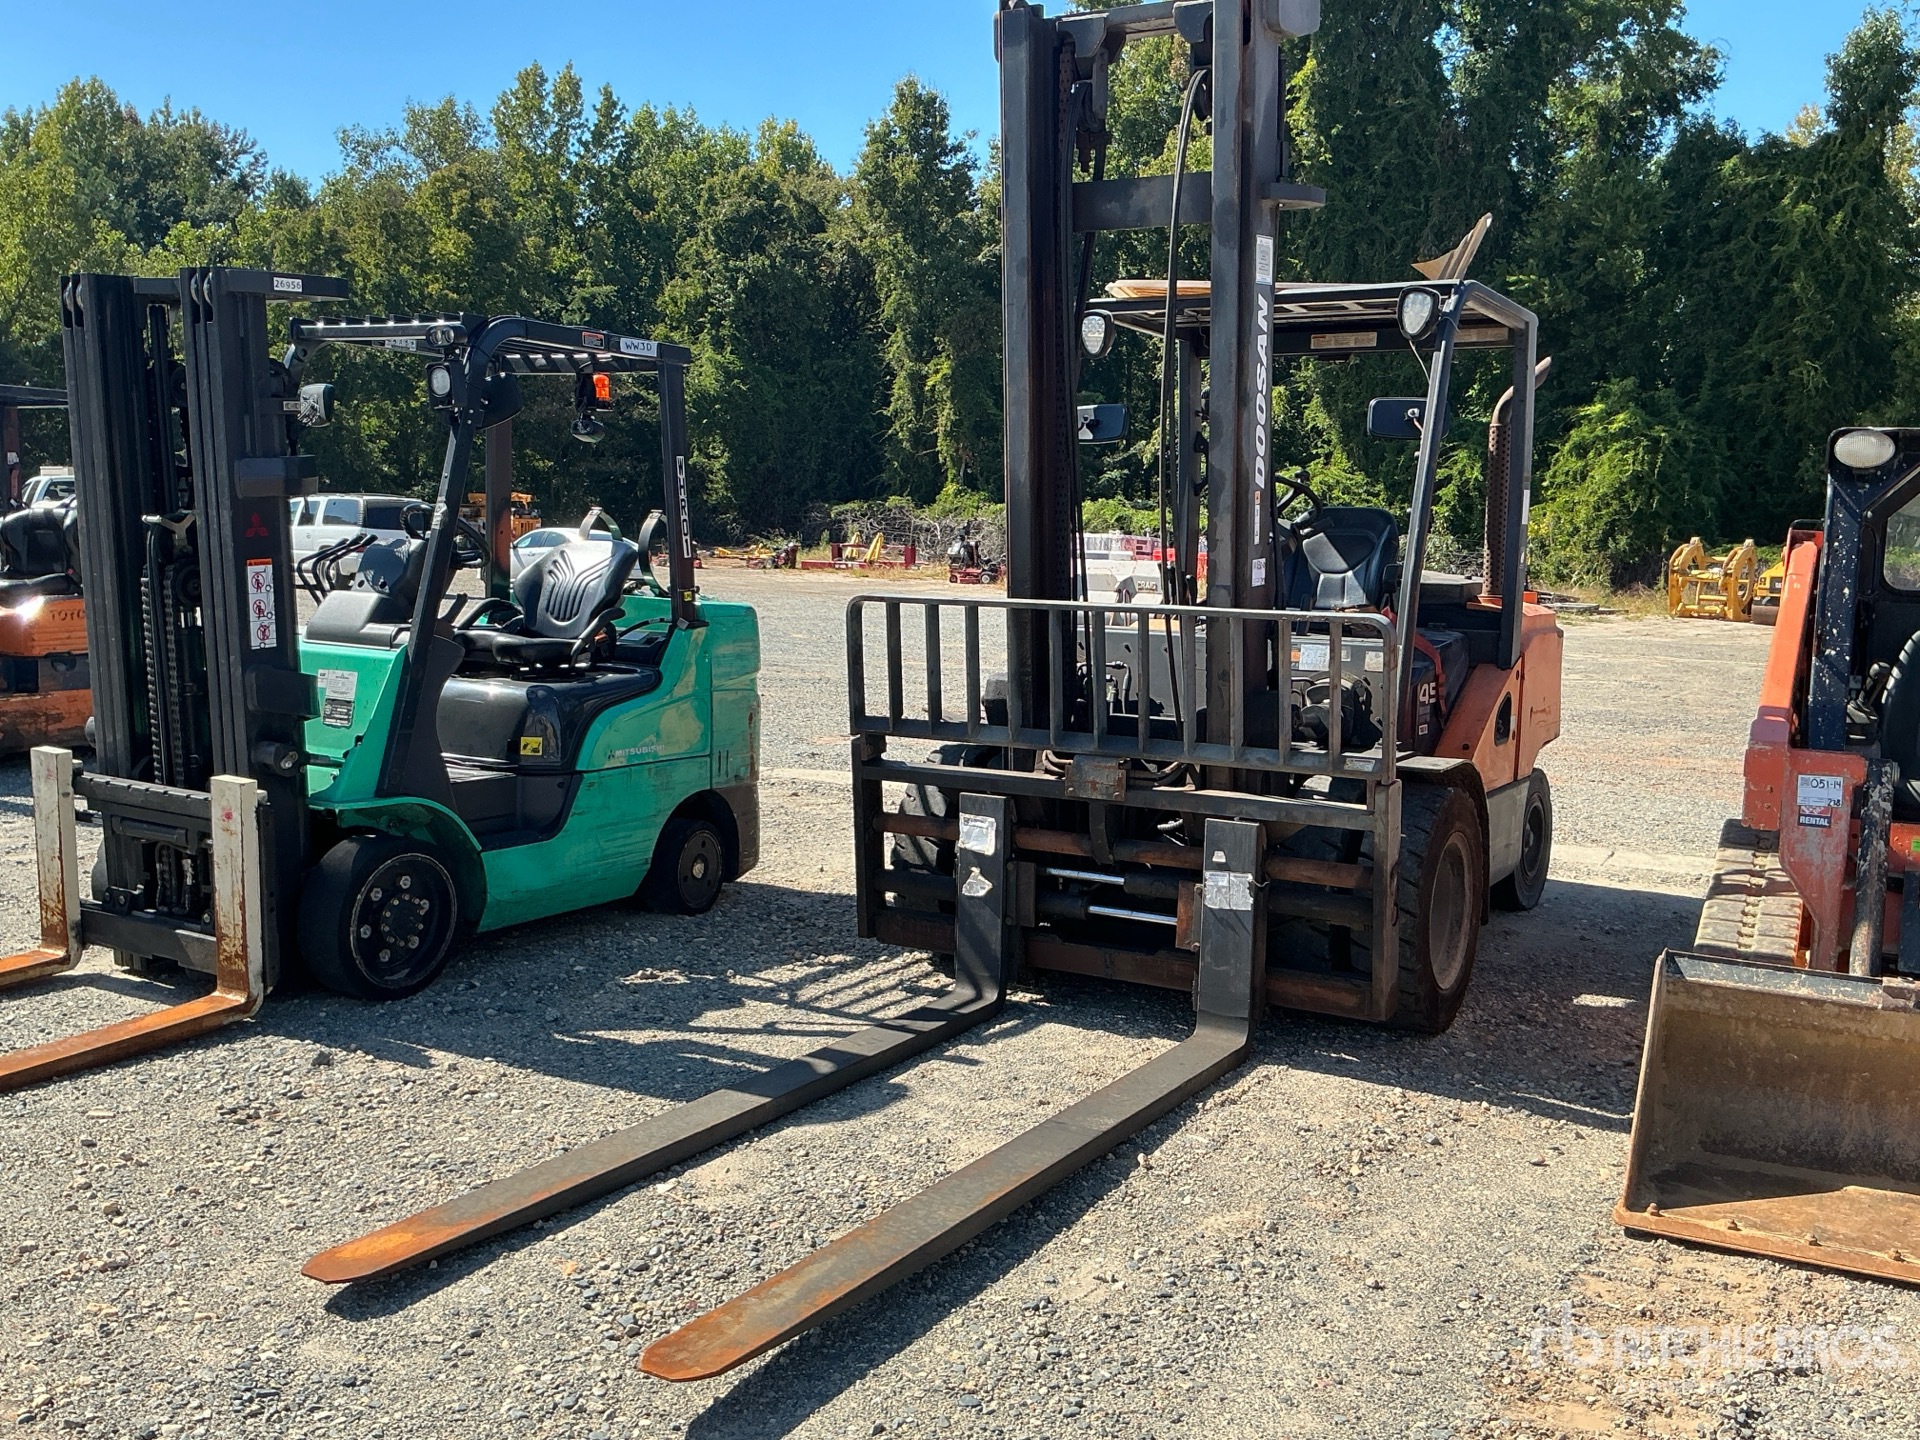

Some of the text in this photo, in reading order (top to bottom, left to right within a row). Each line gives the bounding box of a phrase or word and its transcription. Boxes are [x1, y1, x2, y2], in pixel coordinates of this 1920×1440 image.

[274, 279, 302, 290] 26956
[1254, 293, 1268, 489] DOOSAN
[615, 744, 665, 757] MITSUBISHI
[1800, 815, 1830, 826] RENTAL
